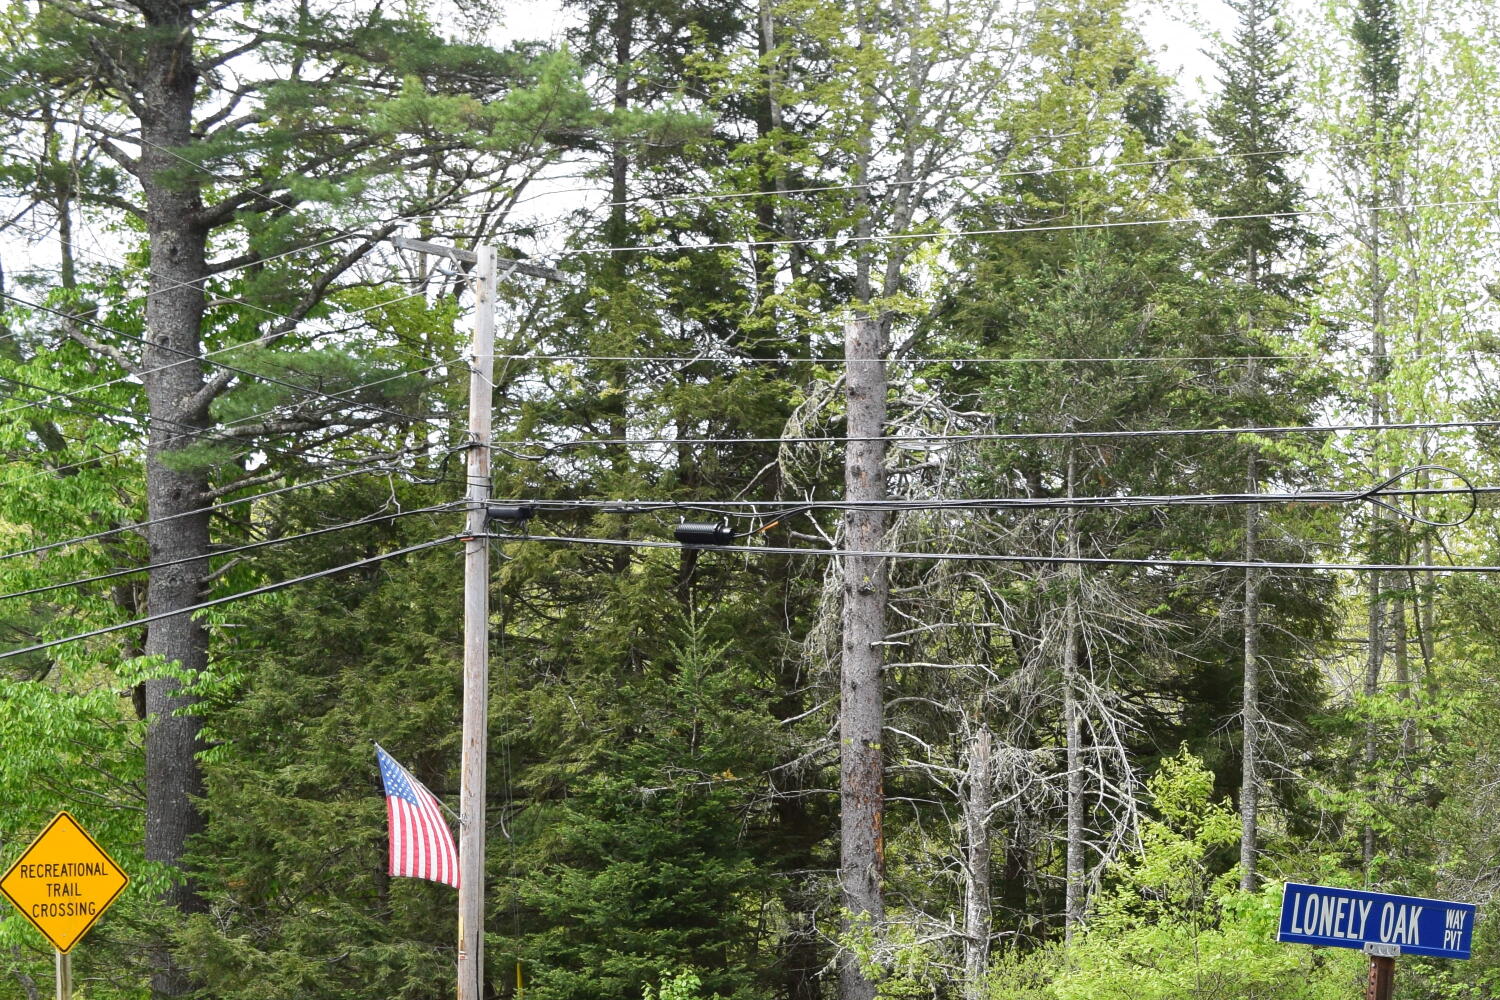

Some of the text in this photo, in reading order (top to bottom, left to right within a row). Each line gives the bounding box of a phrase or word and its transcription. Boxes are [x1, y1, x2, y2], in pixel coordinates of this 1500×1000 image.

[20, 862, 108, 878] RECREATIONAL
[46, 883, 82, 897] TRAIL
[32, 901, 96, 918] CROSSING
[1291, 892, 1423, 946] LONELY OAK
[1445, 908, 1467, 929] WAY
[1443, 929, 1463, 951] PVT
